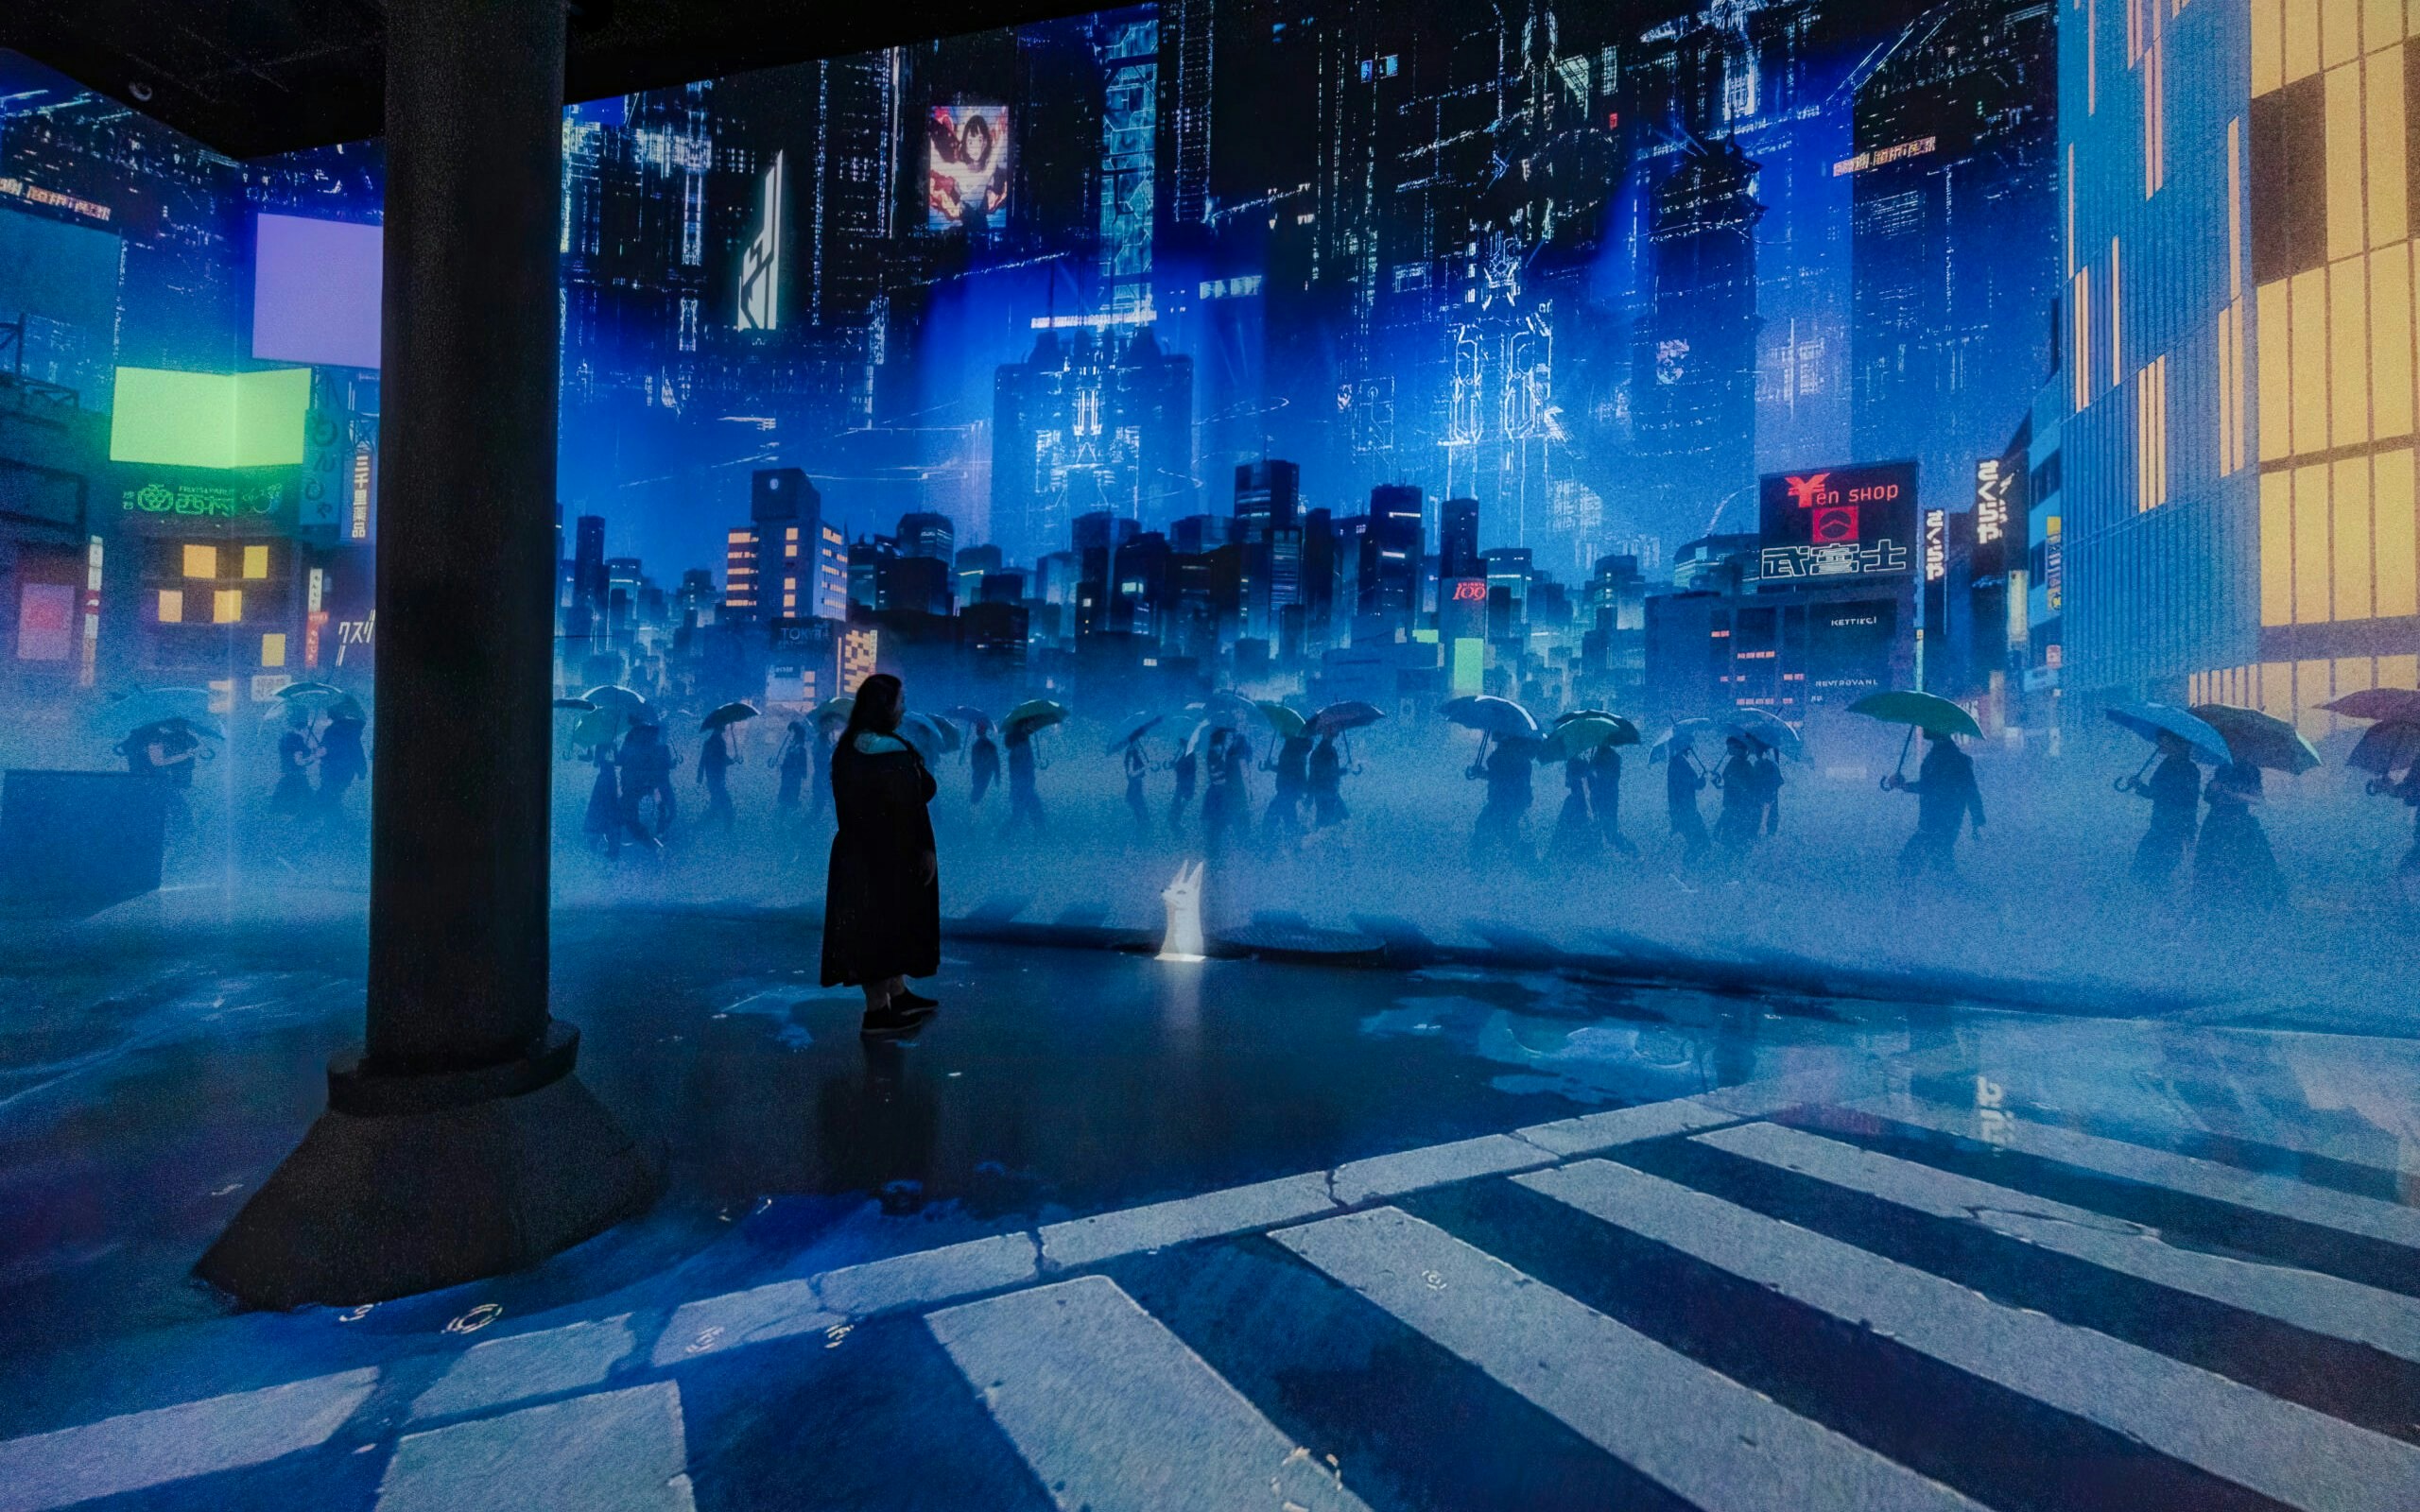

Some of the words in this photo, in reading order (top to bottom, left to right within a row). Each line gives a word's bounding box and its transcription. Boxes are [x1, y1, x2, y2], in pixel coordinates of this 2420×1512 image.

[352, 455, 369, 538] 三千里薬品
[1978, 460, 1999, 543] さくらや
[1761, 539, 1907, 579] 武富士
[1926, 509, 1945, 581] さくらや
[1452, 583, 1486, 600] 109
